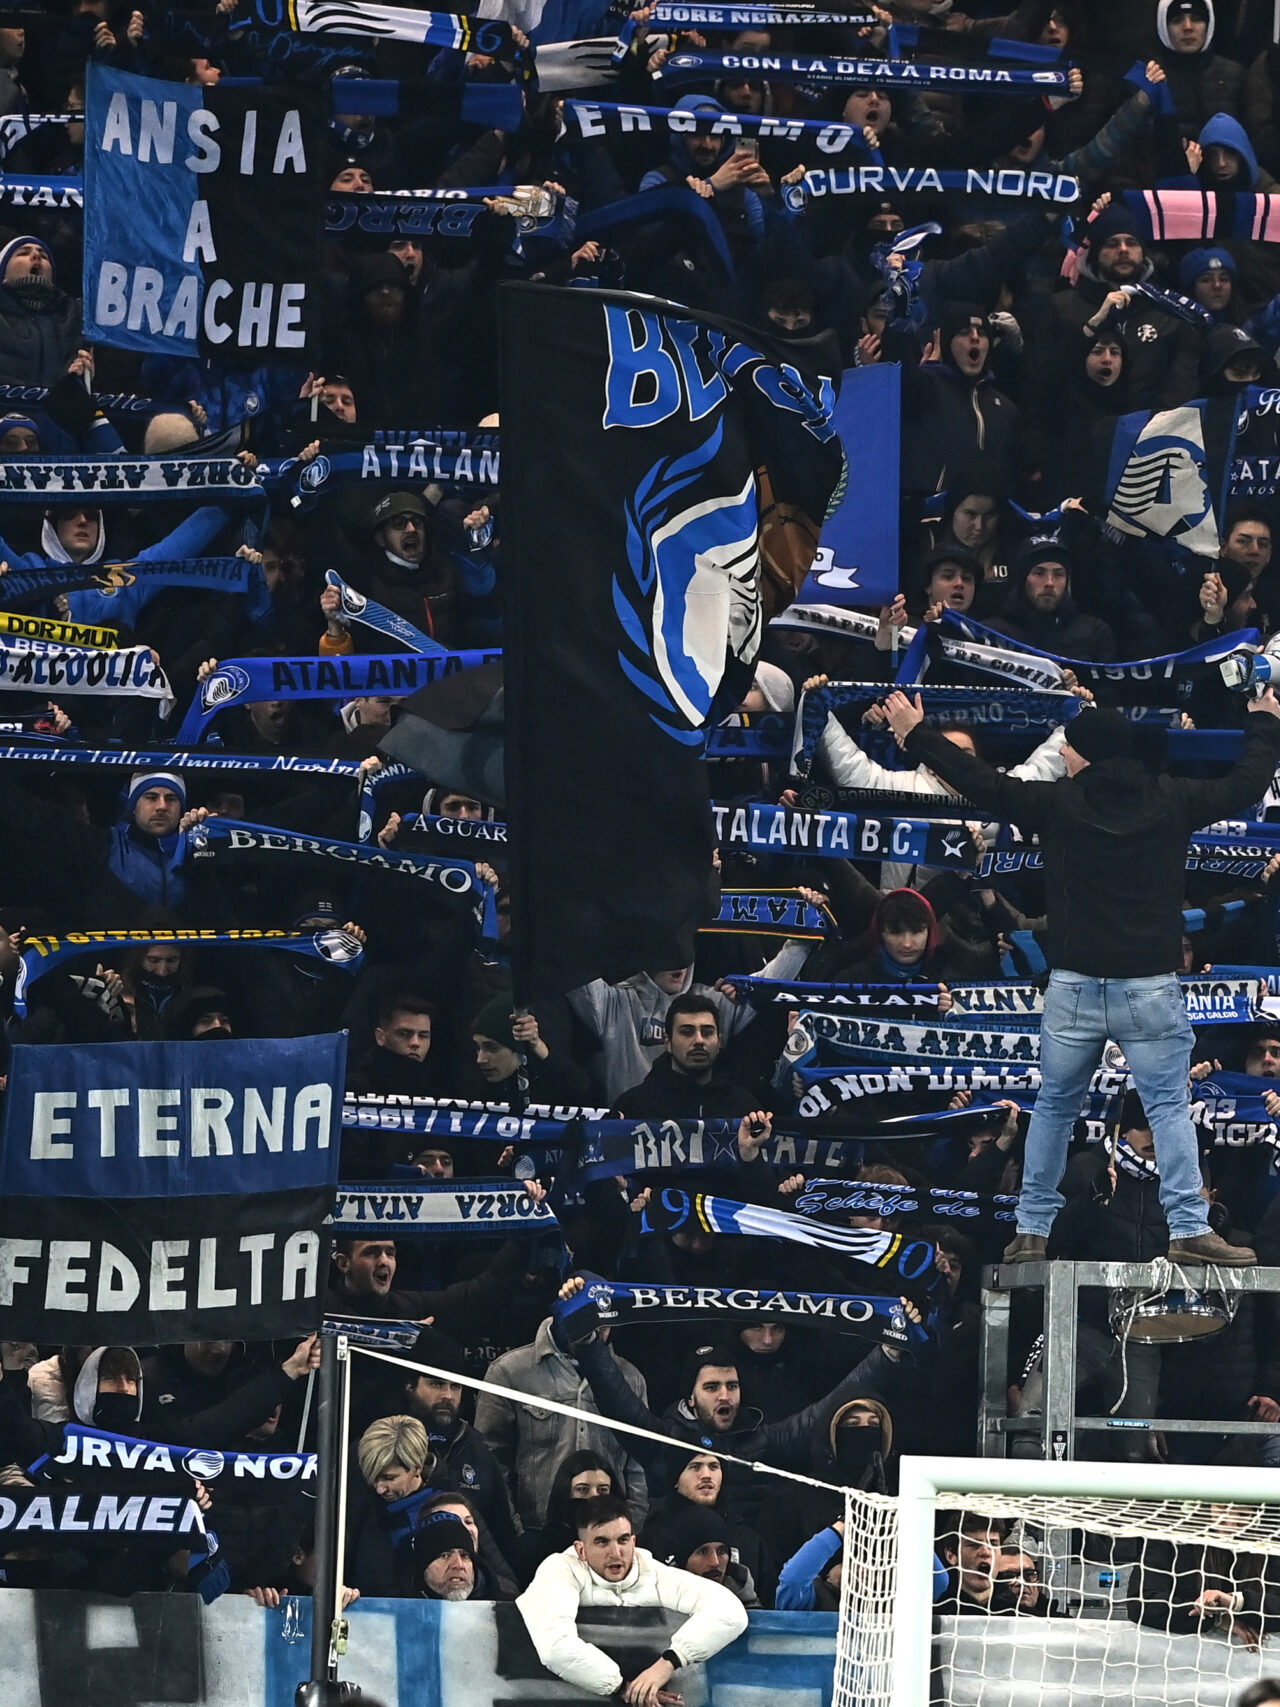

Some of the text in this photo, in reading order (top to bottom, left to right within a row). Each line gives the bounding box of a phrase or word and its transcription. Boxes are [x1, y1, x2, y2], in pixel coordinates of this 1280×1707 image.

[722, 55, 1012, 79] CON LA DEA A ROMA
[101, 92, 307, 175] ANSIA
[568, 103, 854, 154] ERGAMO
[0, 184, 84, 208] TAN
[804, 166, 1080, 203] CURVA NORD
[183, 200, 217, 262] A
[95, 261, 306, 348] BRACHE
[0, 463, 150, 491] ATALAN
[360, 444, 500, 485] ATALAN
[990, 656, 1062, 691] COMIN
[411, 812, 430, 832] A
[711, 806, 919, 858] TALANTA B.C.
[228, 828, 473, 894] BERGAMO
[926, 1028, 1050, 1062] ATALA
[30, 1082, 333, 1161] ETERNA
[0, 1230, 320, 1312] FEDELTA
[628, 1287, 875, 1323] BERGAMO
